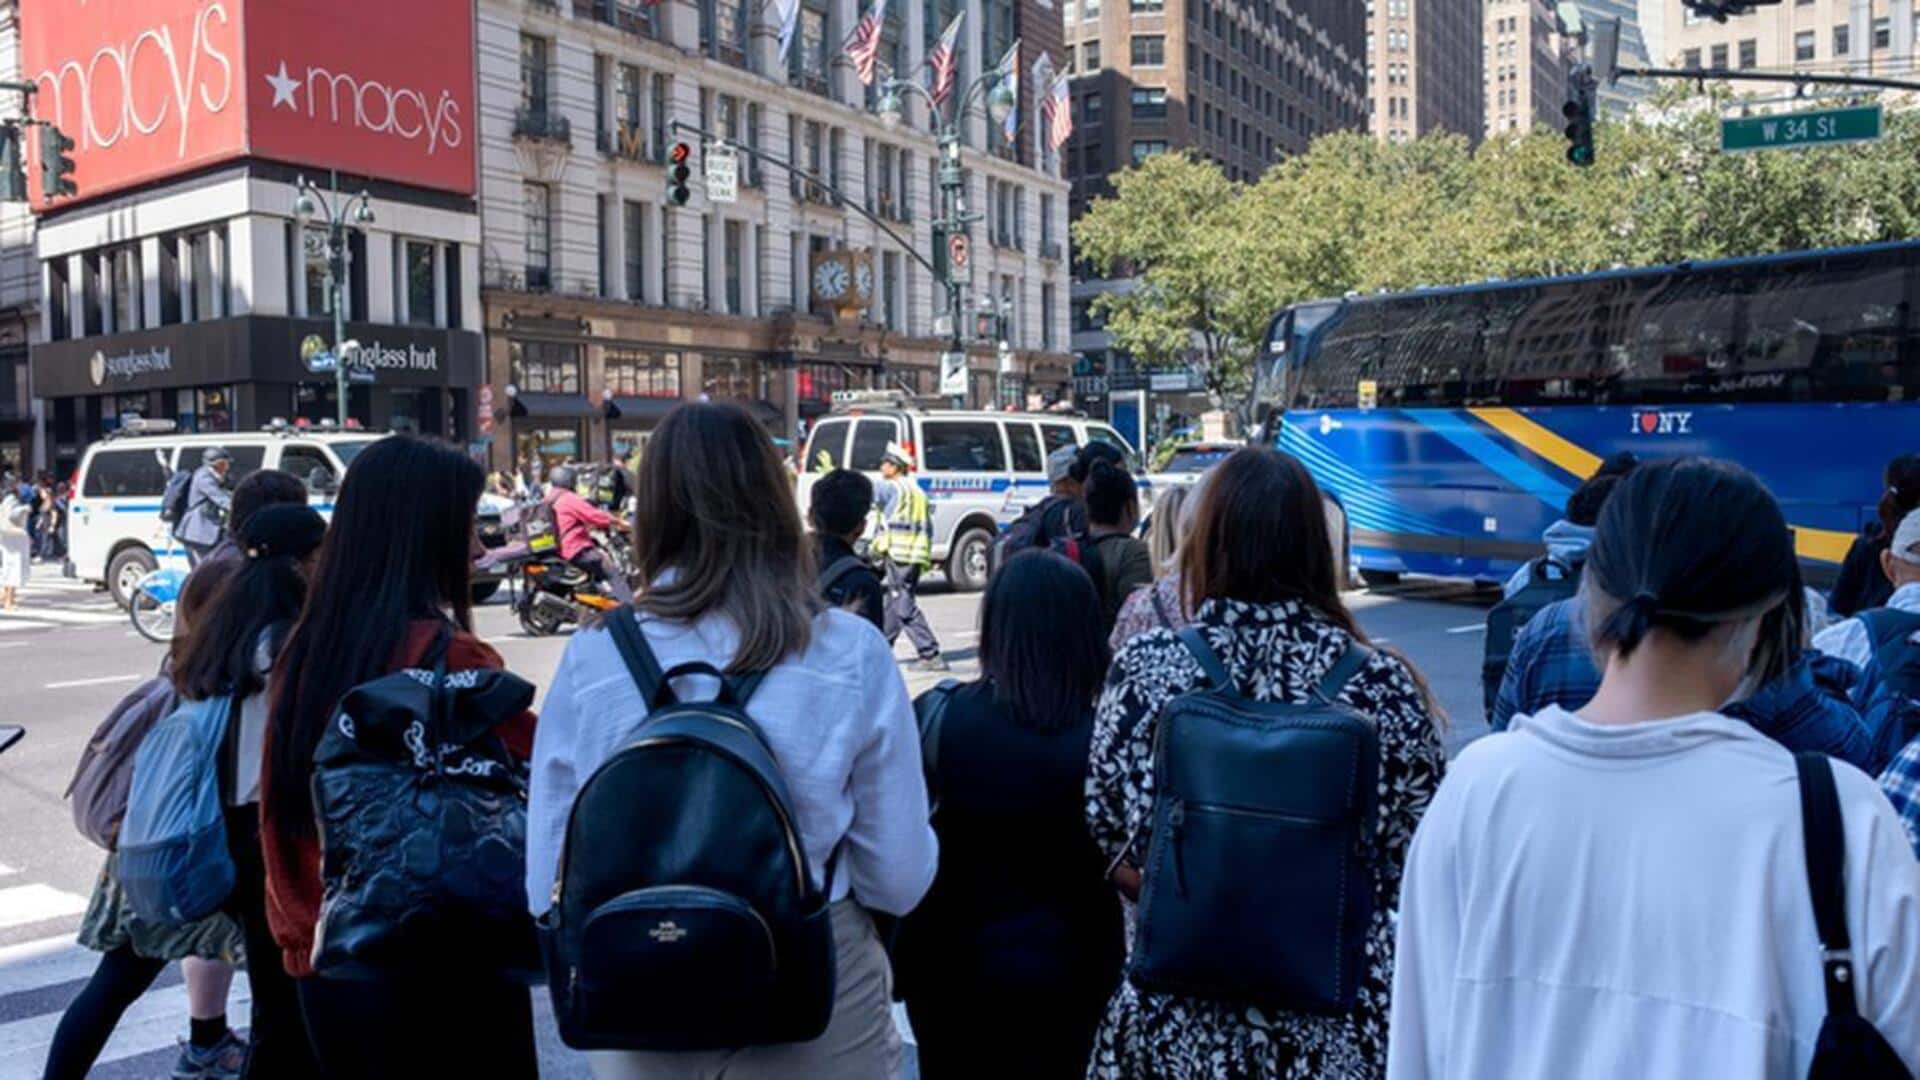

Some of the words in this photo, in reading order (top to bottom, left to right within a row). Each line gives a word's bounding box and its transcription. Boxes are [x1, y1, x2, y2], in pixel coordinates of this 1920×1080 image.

[1762, 121, 1778, 141] W
[1784, 119, 1808, 140] 34
[1816, 116, 1836, 137] St
[409, 343, 437, 370] hut
[1632, 412, 1641, 434] I
[1658, 411, 1692, 434] NY
